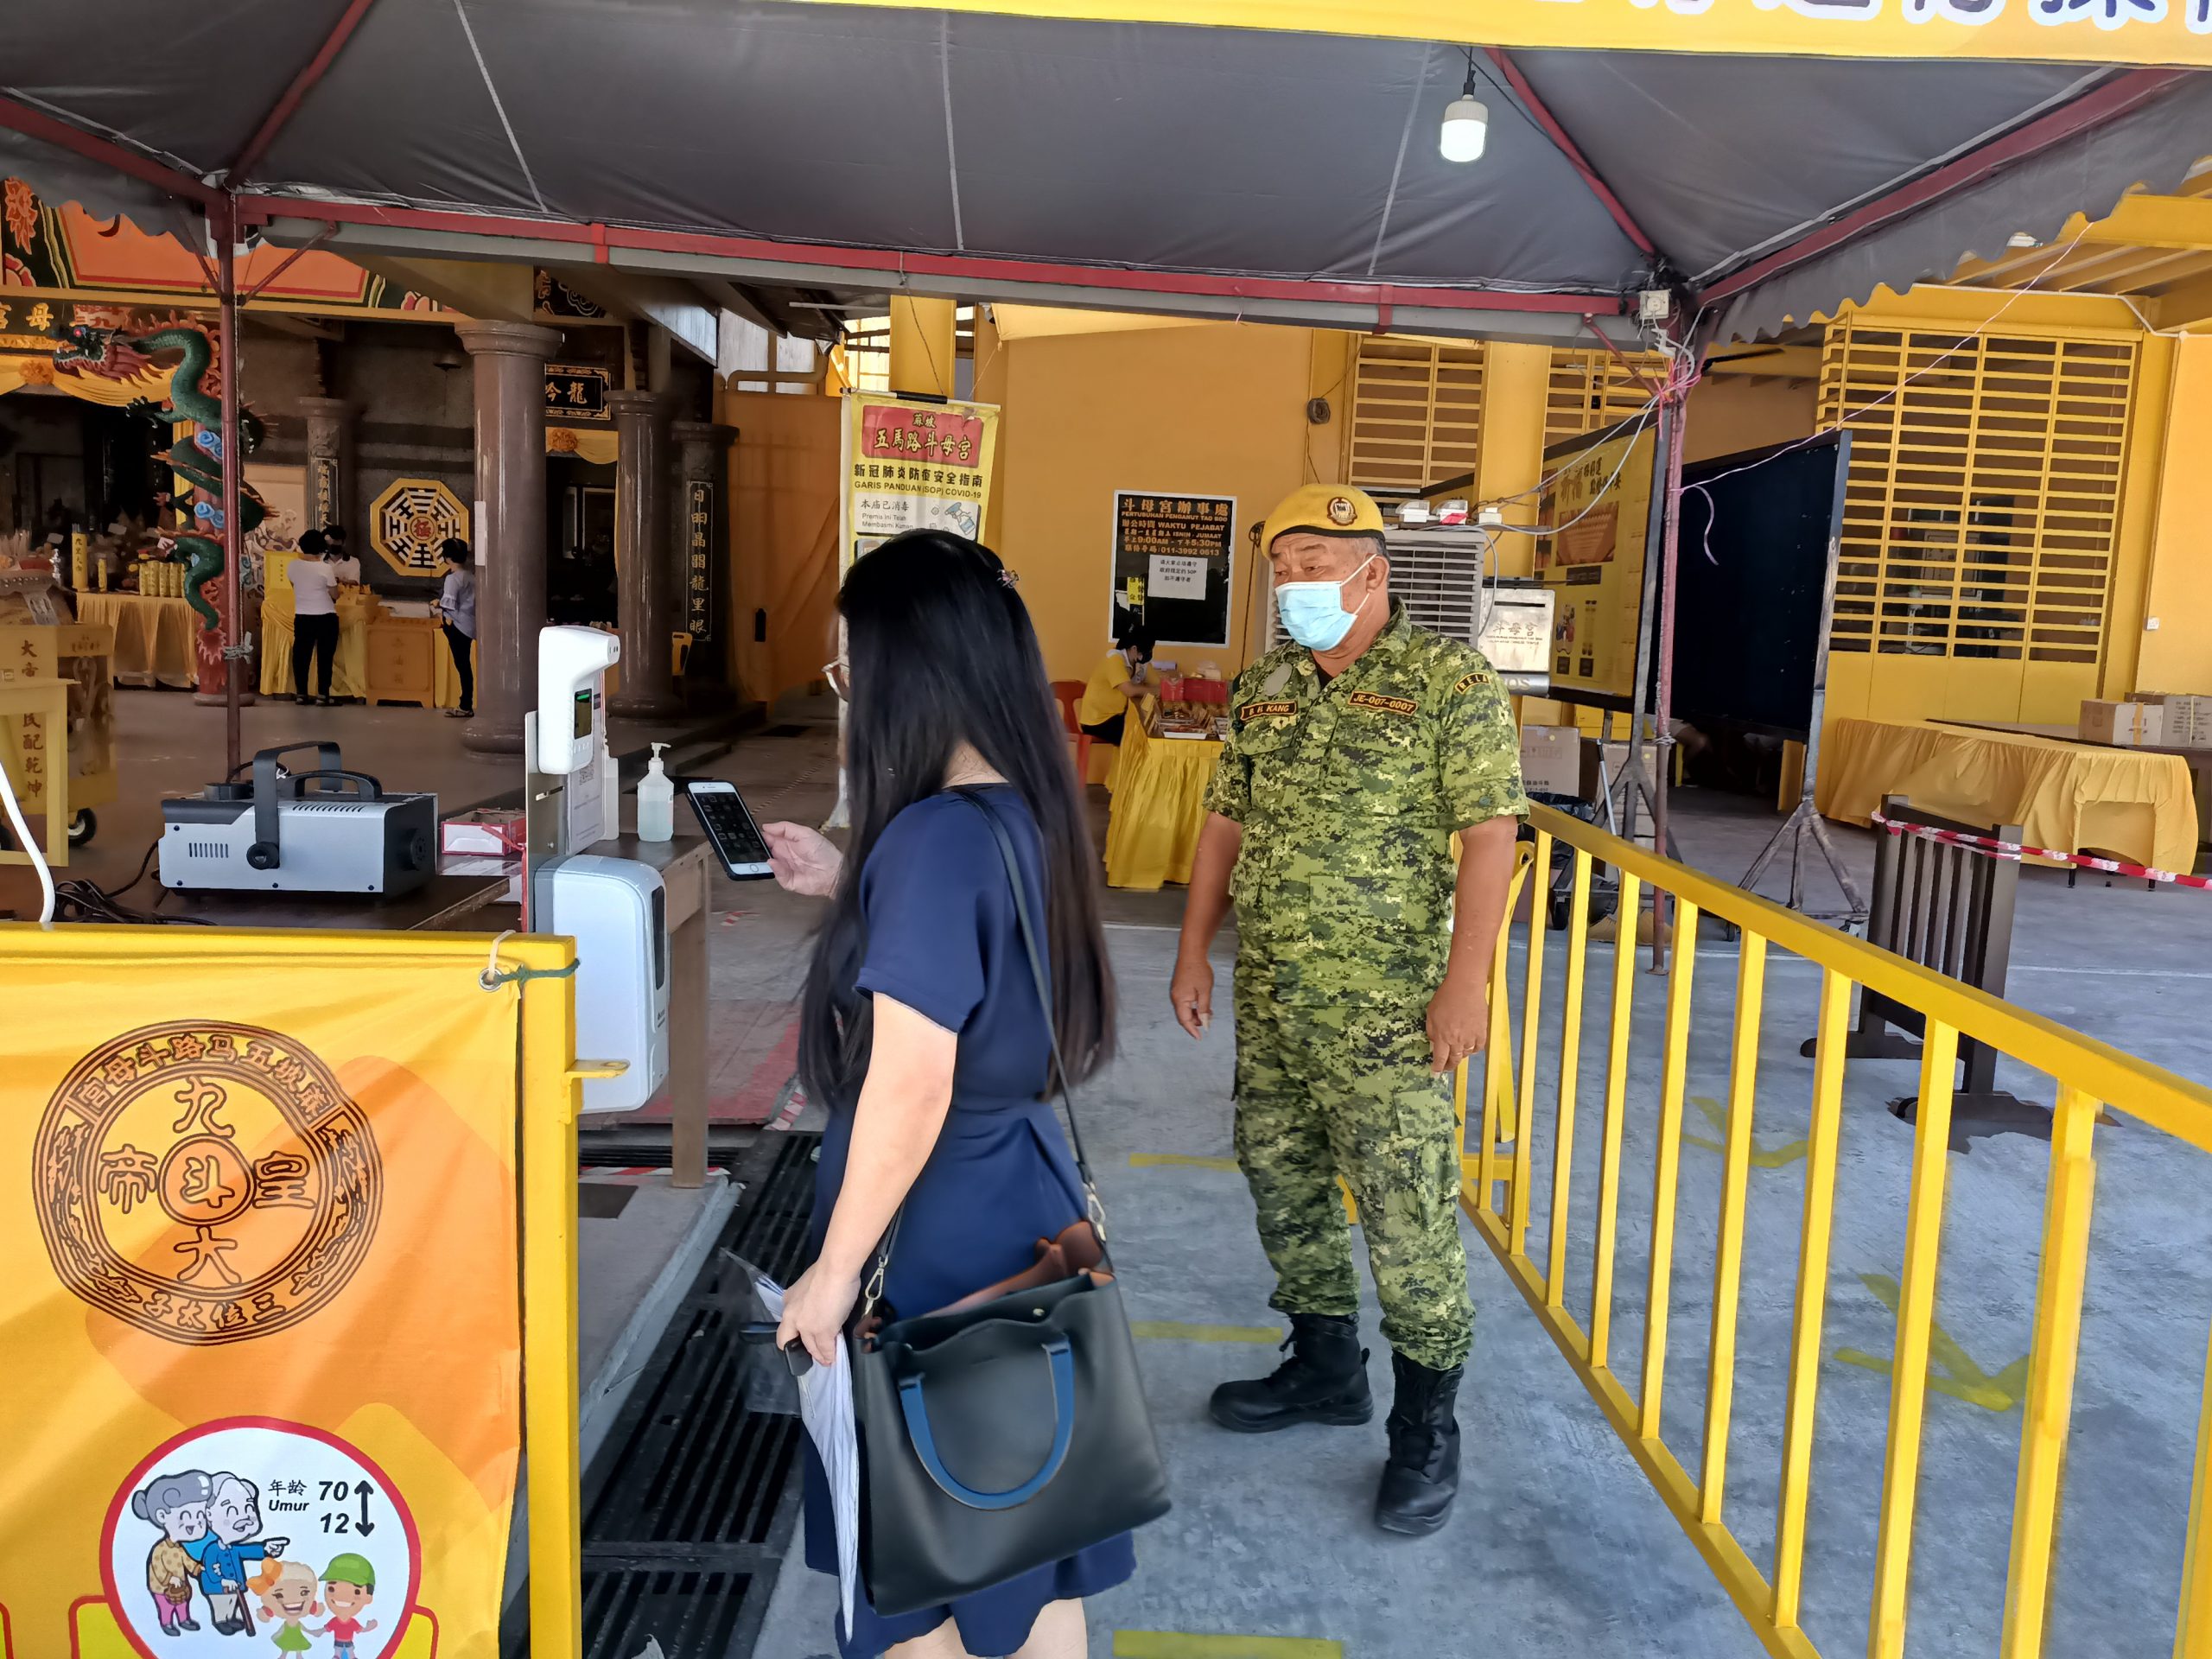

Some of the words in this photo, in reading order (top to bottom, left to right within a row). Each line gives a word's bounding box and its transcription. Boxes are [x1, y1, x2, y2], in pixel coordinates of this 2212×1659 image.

[855, 480, 881, 490] GARIS
[884, 482, 921, 493] PANDUAN
[945, 488, 982, 499] COVID-19
[1158, 521, 1186, 530] WAKTU
[1266, 704, 1290, 713] KANG
[1353, 694, 1414, 713] JE-007-0007
[268, 1479, 308, 1497] 年龄
[319, 1481, 349, 1501] 70
[269, 1499, 309, 1511] Umur
[320, 1512, 349, 1534] 12
